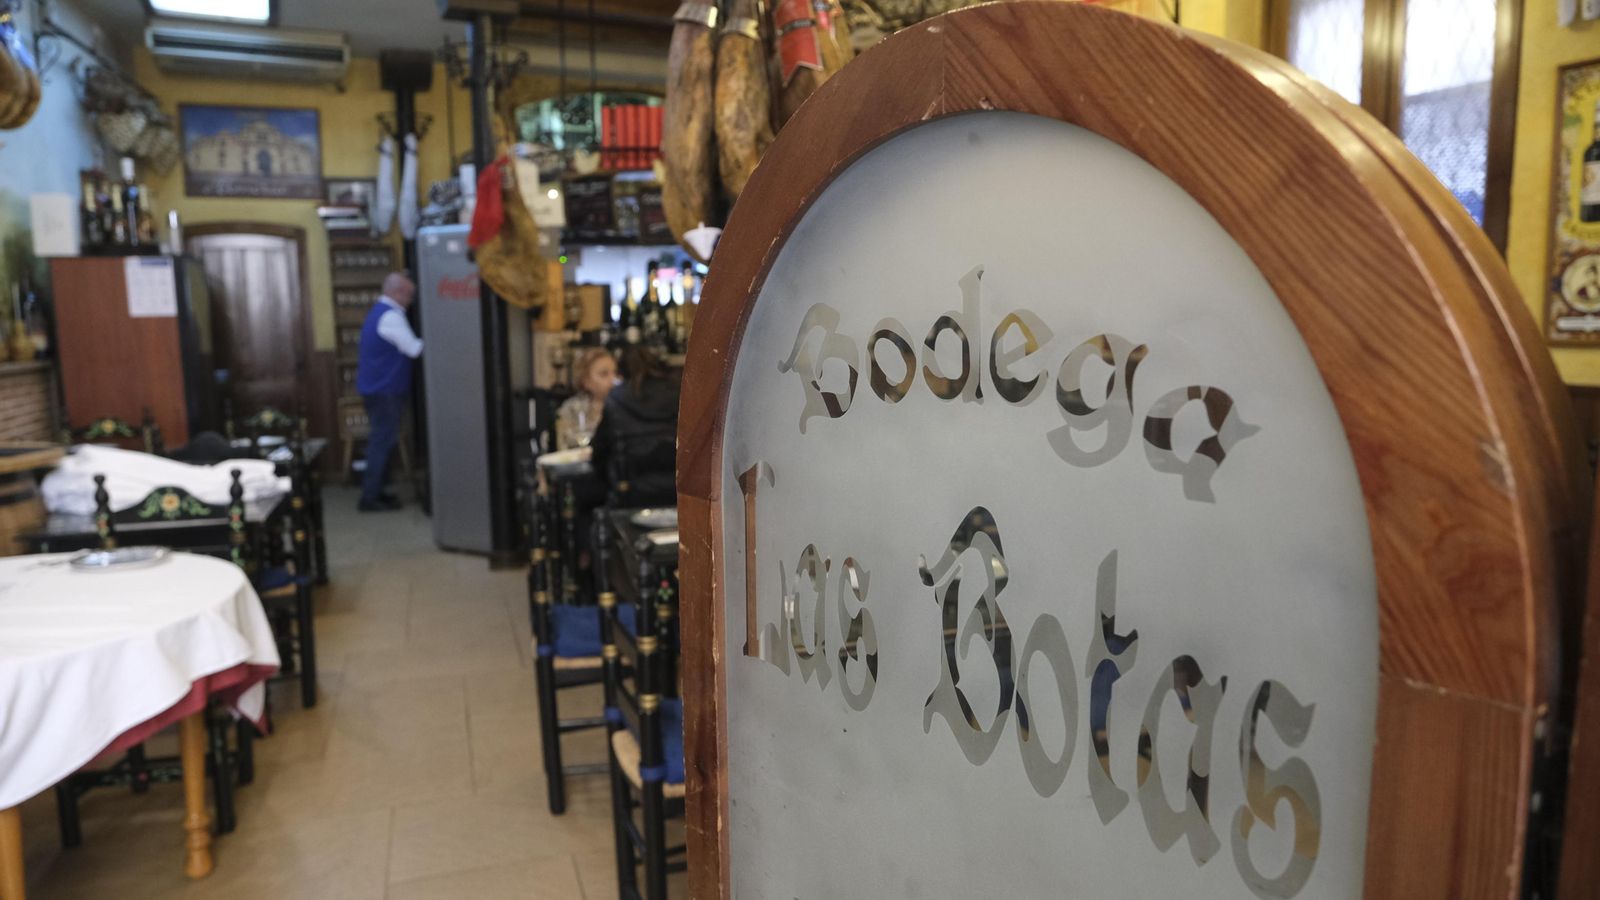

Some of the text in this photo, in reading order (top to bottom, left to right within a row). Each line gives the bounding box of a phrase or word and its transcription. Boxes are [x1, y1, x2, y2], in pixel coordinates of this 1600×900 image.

[777, 264, 1262, 504] Bodega
[734, 460, 1322, 899] Las Botas
